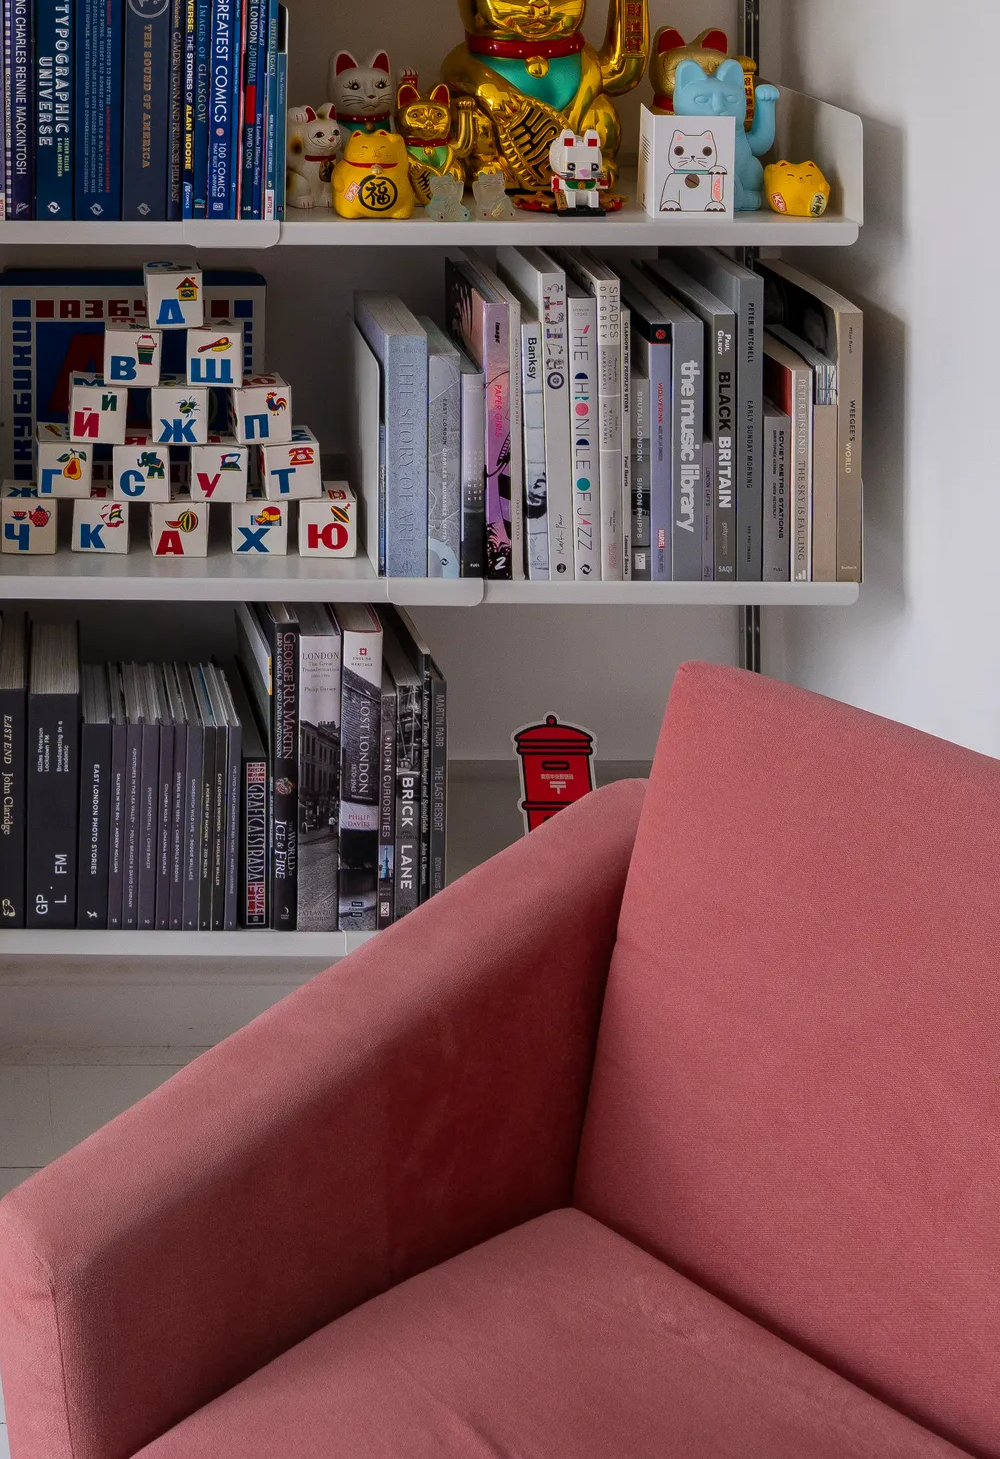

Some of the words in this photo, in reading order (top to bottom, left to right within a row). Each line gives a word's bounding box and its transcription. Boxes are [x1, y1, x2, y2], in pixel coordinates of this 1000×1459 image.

[15, 17, 26, 64] CHARLES
[143, 24, 153, 48] THE
[15, 66, 26, 104] RENNIE
[55, 4, 69, 133] TYPOGRAPHIC
[143, 51, 152, 91] SOUND
[38, 56, 53, 146] UNIVERSE
[143, 94, 152, 109] OF
[214, 65, 227, 123] COMICS
[15, 106, 27, 175] MACKINTOSH
[141, 113, 151, 169] AMERICA
[364, 180, 391, 206] 福
[155, 298, 185, 325] Д
[526, 337, 539, 379] Banksy
[574, 324, 590, 361] THE
[110, 355, 136, 381] В
[190, 357, 233, 384] Ш
[680, 359, 700, 396] the
[101, 391, 117, 412] Й
[718, 371, 731, 431] BLACK
[73, 407, 100, 438] Й
[159, 418, 198, 443] Ж
[243, 413, 269, 440] П
[575, 372, 590, 470] CHRONICLE
[680, 398, 700, 461] music
[41, 468, 62, 494] Г
[119, 469, 146, 497] С
[196, 472, 221, 498] У
[271, 467, 296, 494] Т
[577, 477, 591, 501] OF
[718, 436, 731, 508] BRITAIN
[676, 464, 700, 532] library
[4, 523, 30, 550] Ч
[80, 523, 106, 549] К
[155, 530, 185, 555] А
[236, 526, 270, 553] Х
[307, 523, 349, 549] Ю
[577, 507, 592, 551] JAZZ
[283, 632, 296, 681] GEORGE
[283, 708, 296, 759] MARTIN
[359, 700, 370, 730] LOST
[358, 736, 369, 793] LONDON
[401, 777, 414, 827] BRICK
[400, 844, 413, 890] LANE
